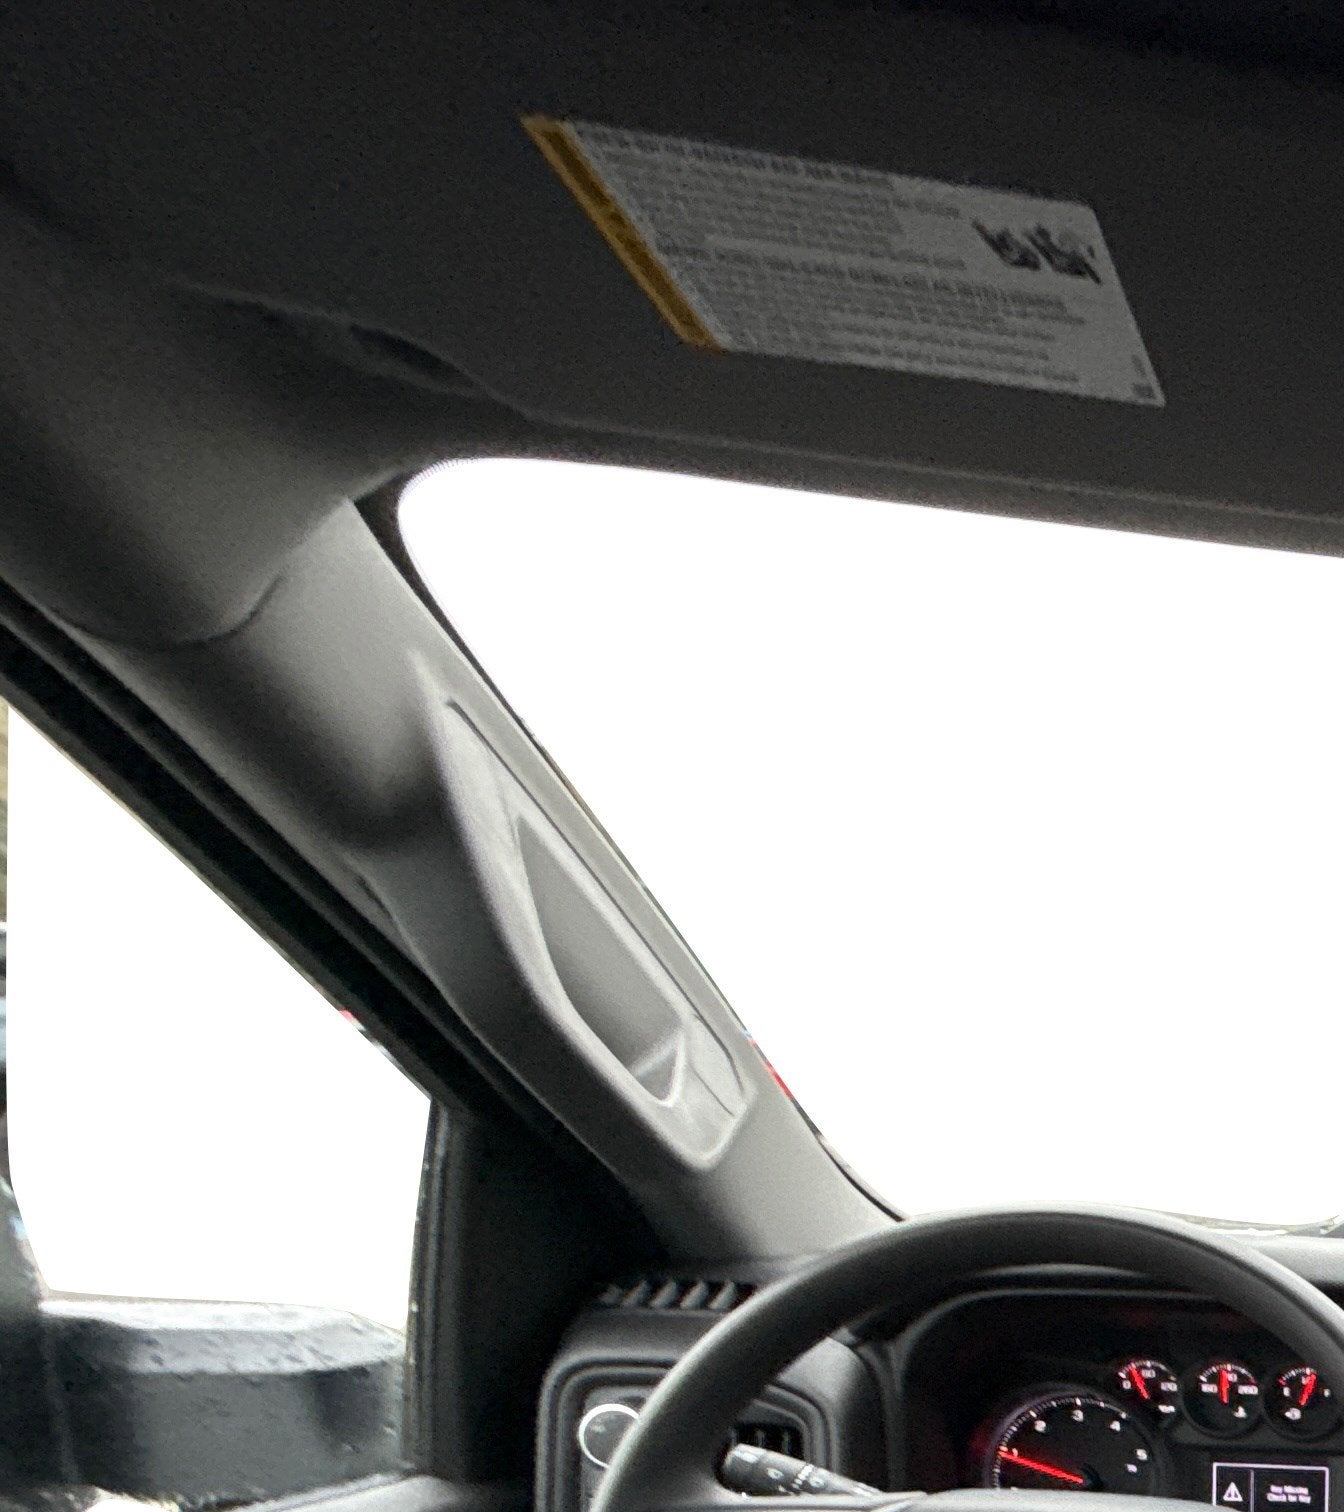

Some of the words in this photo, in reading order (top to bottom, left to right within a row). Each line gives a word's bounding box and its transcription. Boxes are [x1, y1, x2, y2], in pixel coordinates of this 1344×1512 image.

[1071, 1409, 1084, 1423] 3
[1034, 1419, 1047, 1433] 2
[1109, 1420, 1121, 1432] 4
[1136, 1448, 1148, 1461] 5
